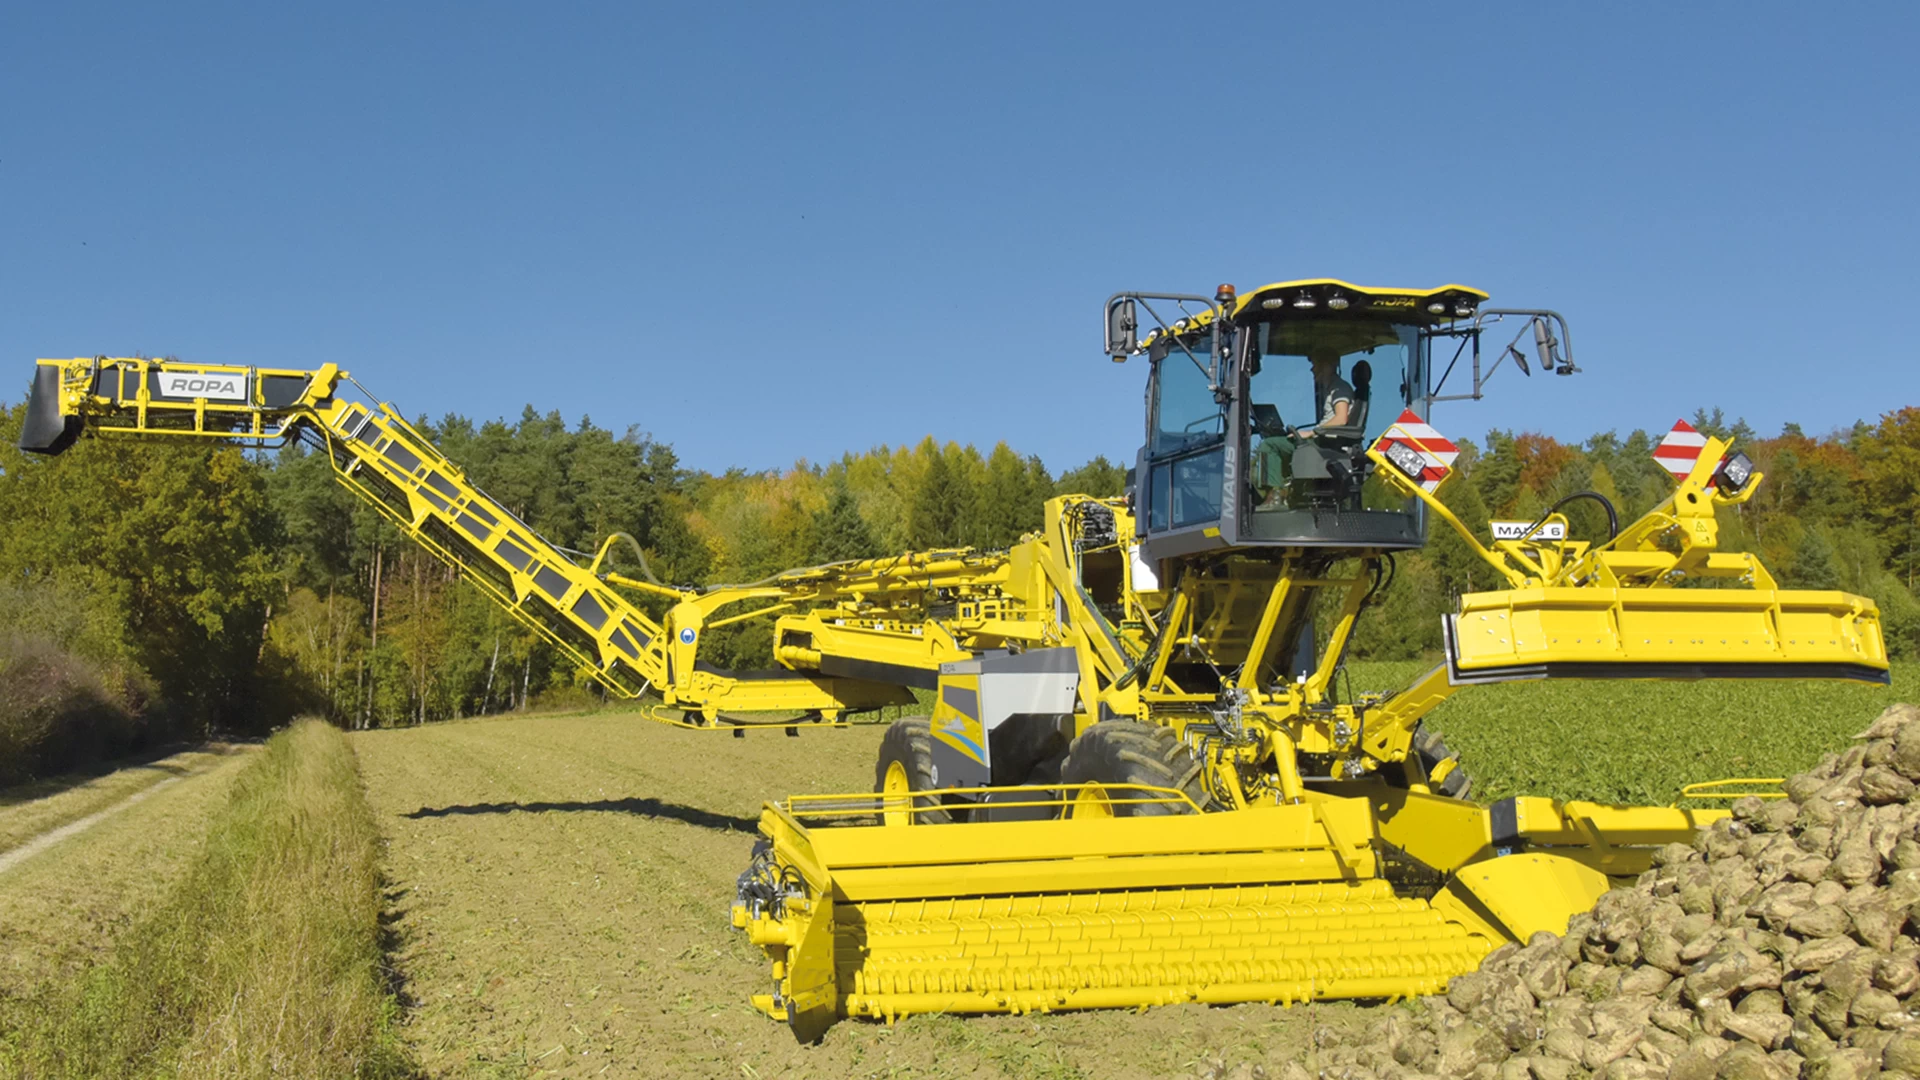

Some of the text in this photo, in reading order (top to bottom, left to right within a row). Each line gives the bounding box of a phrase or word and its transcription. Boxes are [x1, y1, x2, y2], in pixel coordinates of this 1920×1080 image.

[170, 379, 235, 393] ROPA
[1222, 446, 1236, 519] MAUS
[1551, 527, 1561, 536] 6
